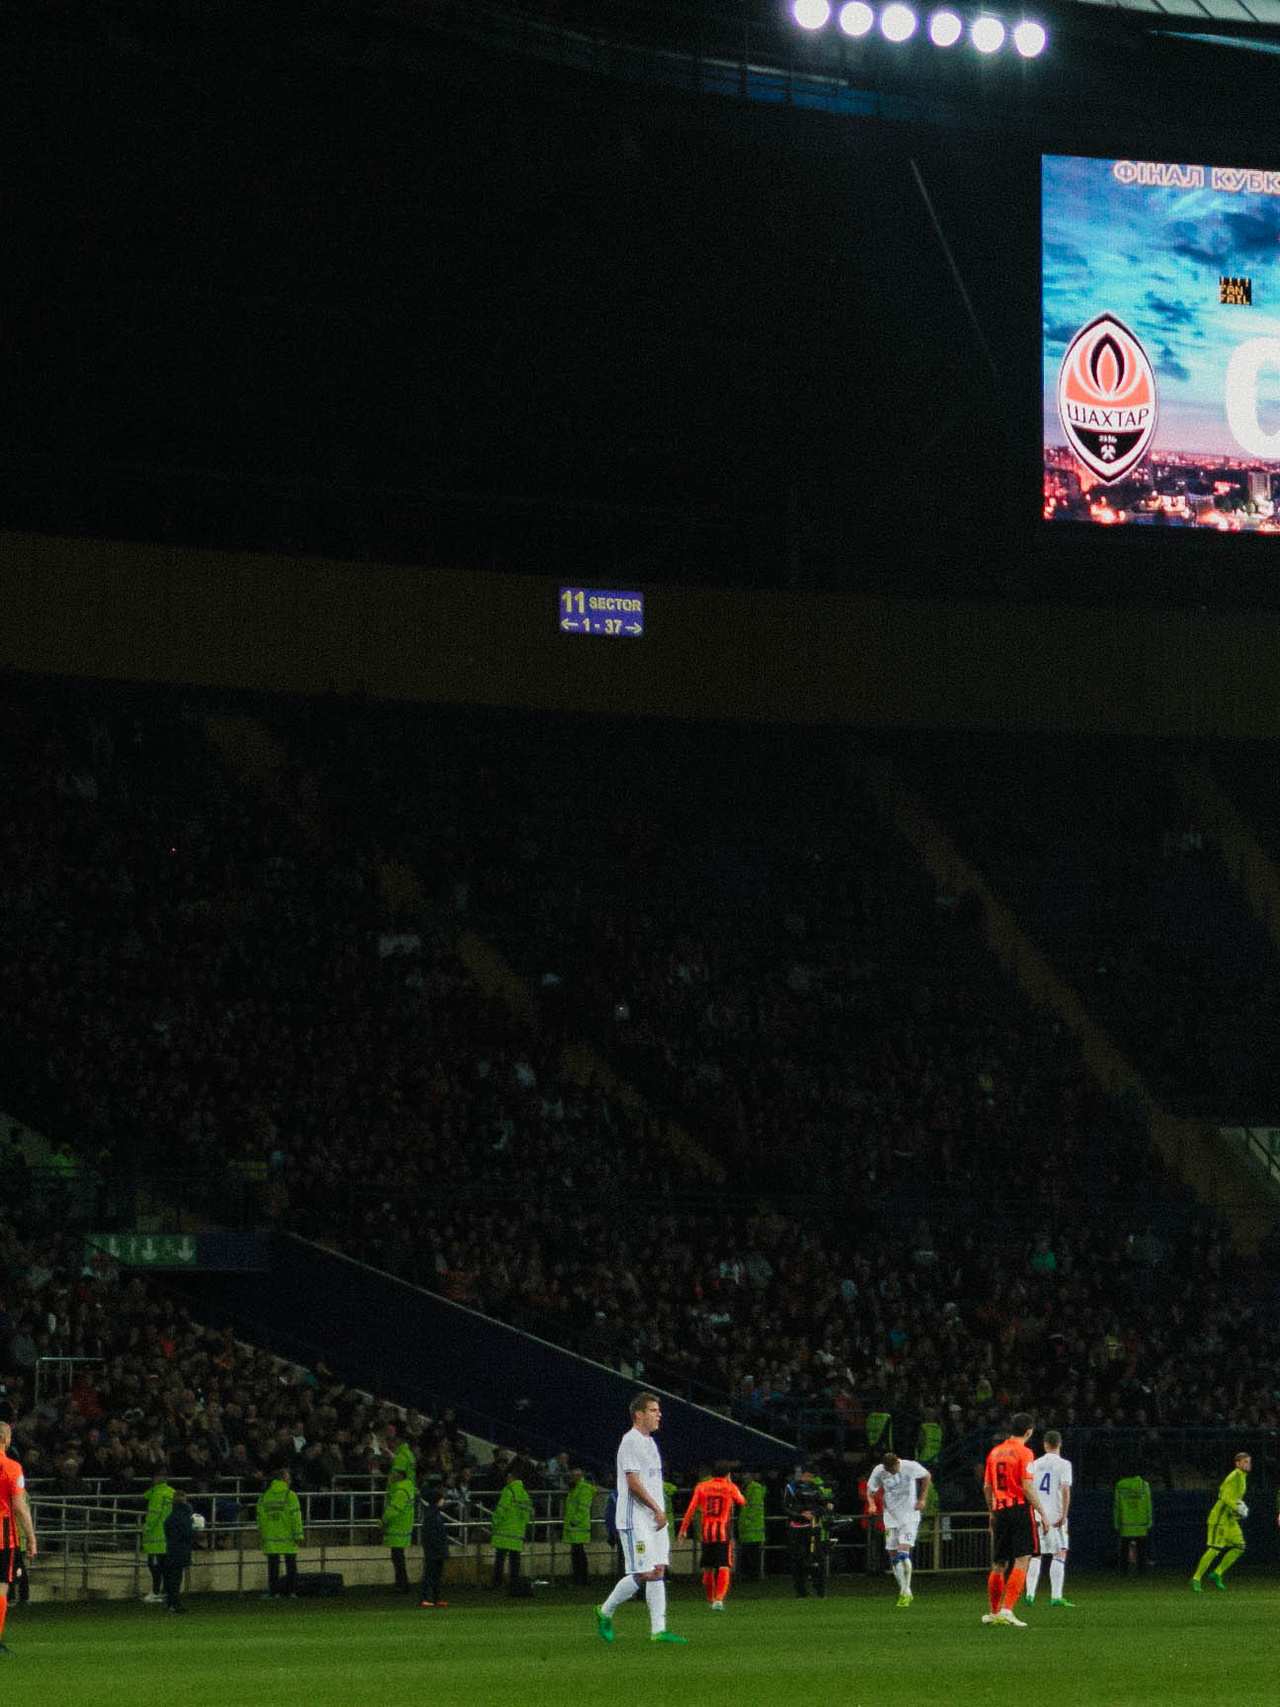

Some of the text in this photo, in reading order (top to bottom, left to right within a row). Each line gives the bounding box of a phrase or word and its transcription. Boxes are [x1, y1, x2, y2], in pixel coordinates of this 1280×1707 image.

[1113, 160, 1204, 187] ФІНАЛ
[1067, 403, 1149, 427] ШАХТАР
[562, 590, 641, 613] 11 SECTOR
[583, 617, 590, 631] 1
[605, 619, 622, 633] 37
[1039, 1473, 1050, 1495] 4
